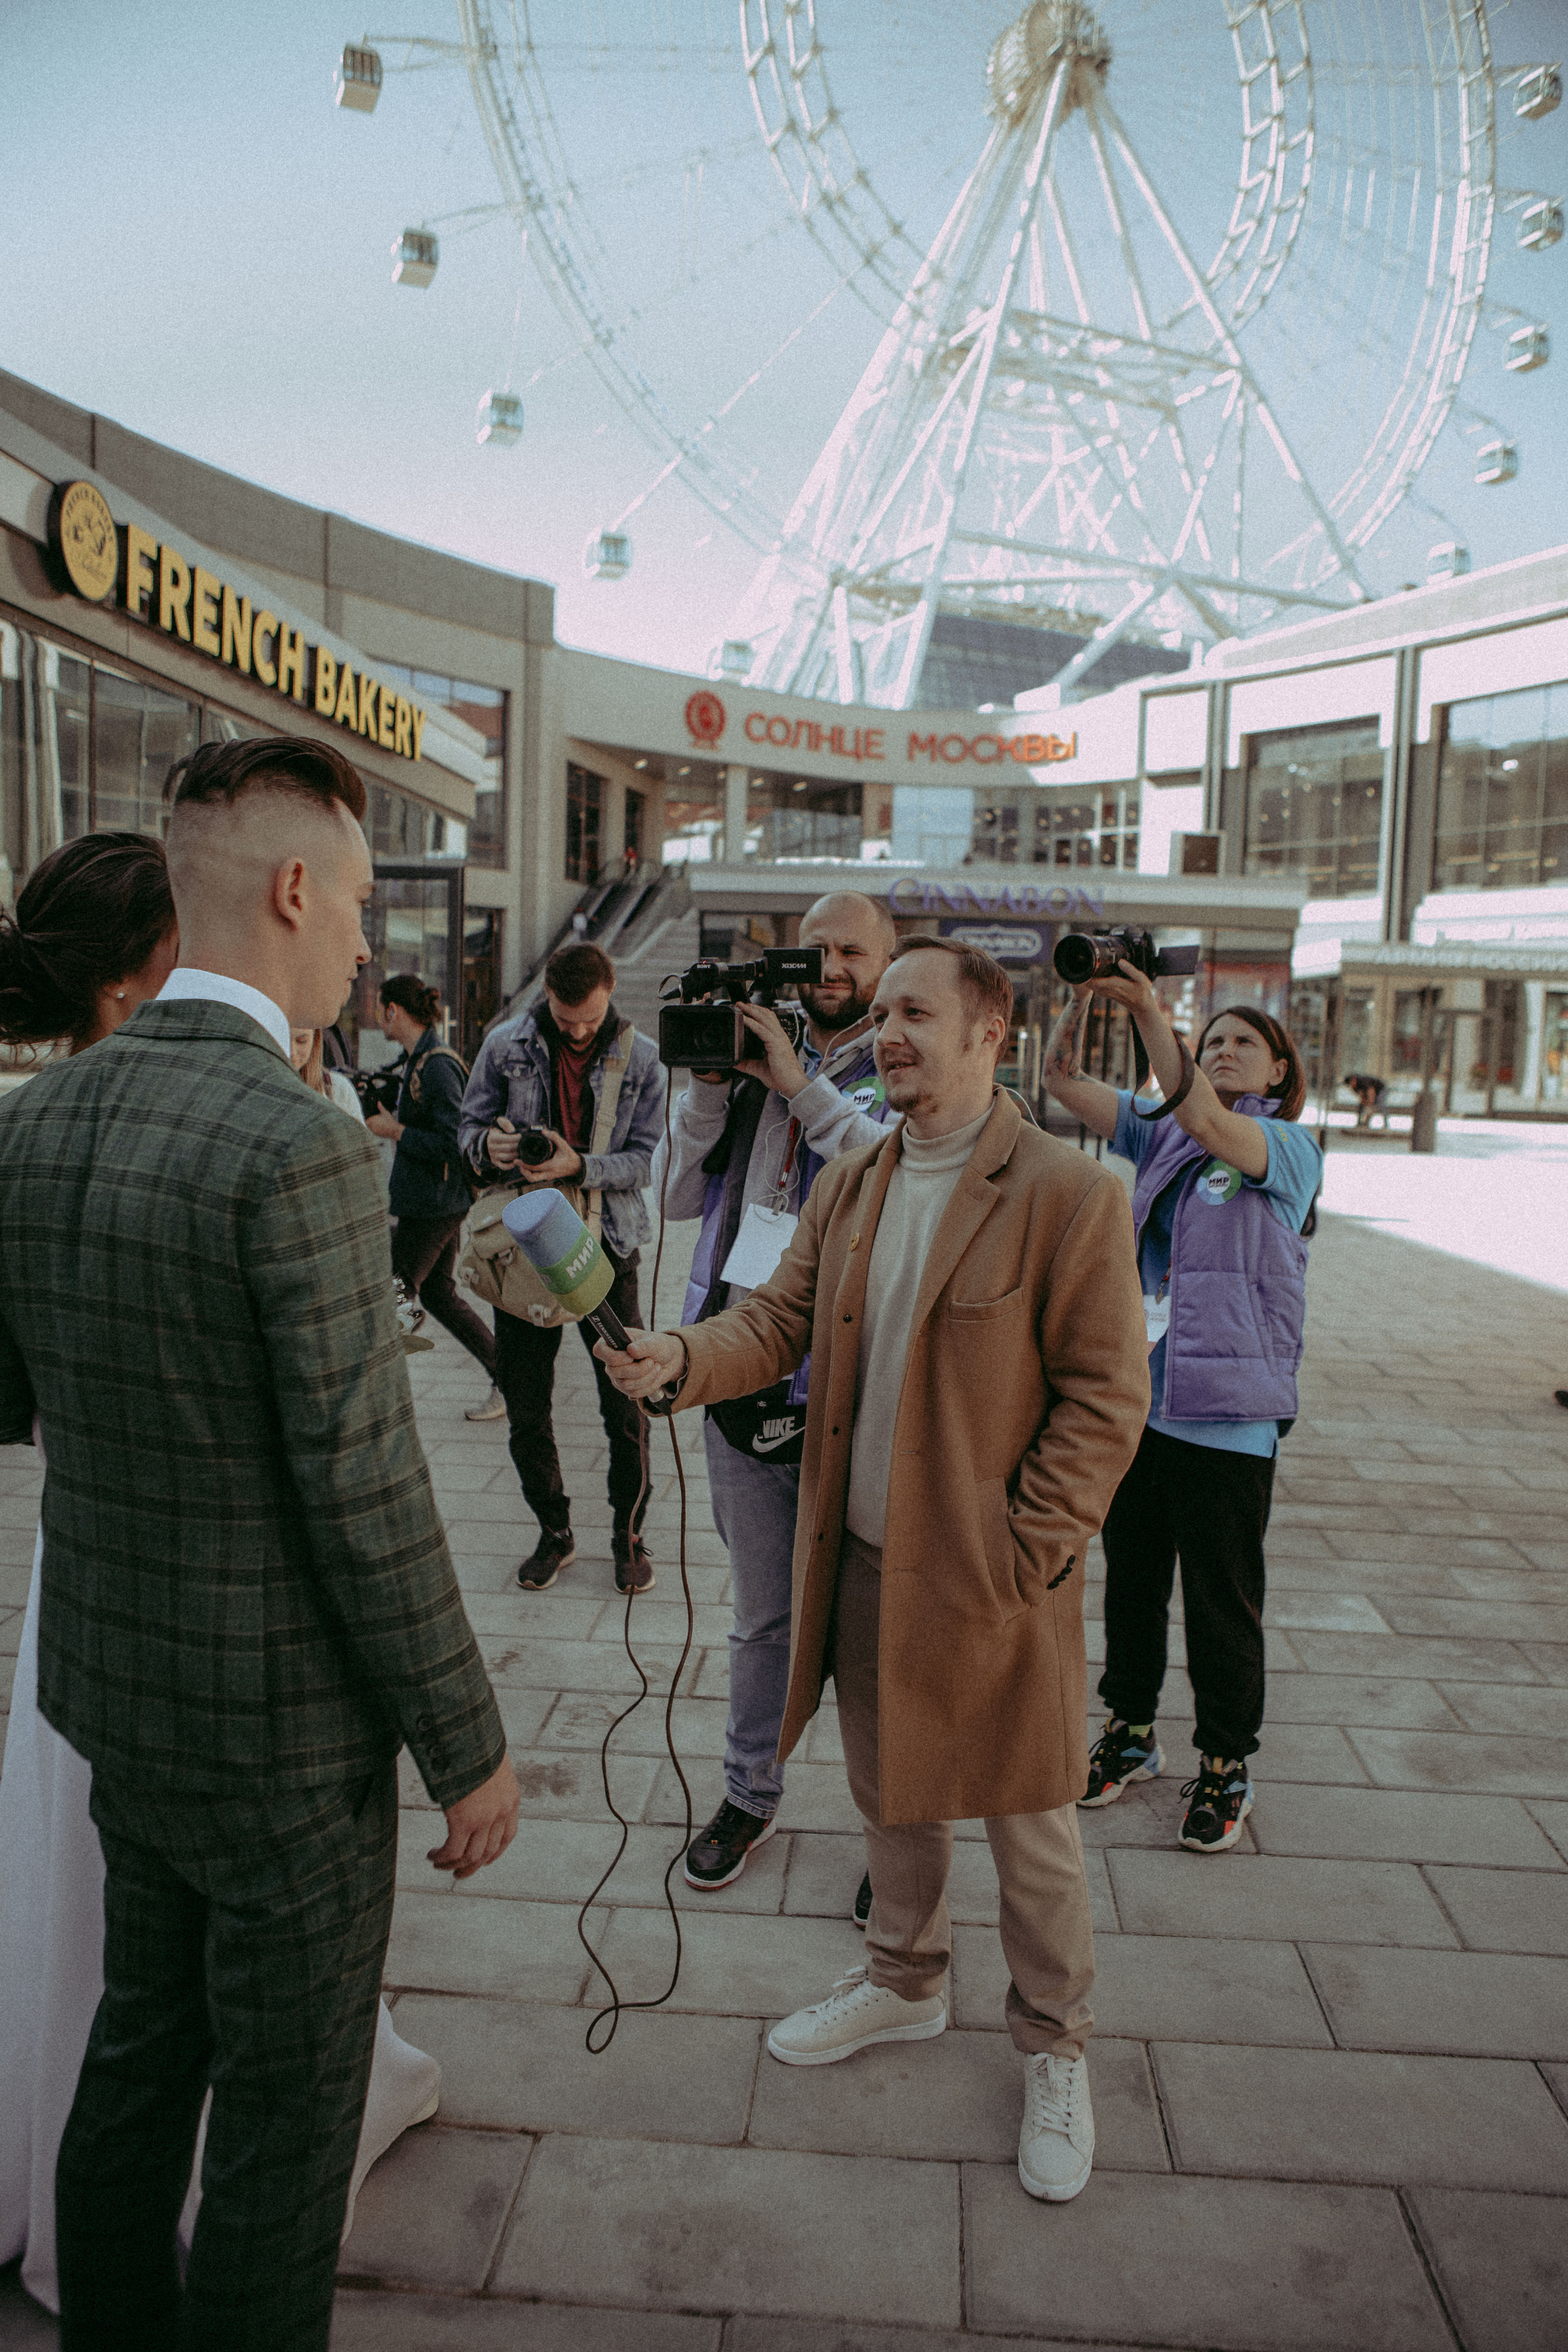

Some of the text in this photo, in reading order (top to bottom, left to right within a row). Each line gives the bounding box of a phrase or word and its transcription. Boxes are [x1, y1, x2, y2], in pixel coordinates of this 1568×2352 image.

[127, 522, 426, 761] FRENCH BAKERY
[745, 712, 1077, 764] СОЛНЦЕ МОСКВЫ
[889, 877, 1103, 916] CINNABON
[854, 1093, 875, 1102] МИР
[1208, 1177, 1229, 1185] МИР
[565, 1236, 594, 1279] МИР
[597, 1322, 619, 1349] SENNHEISER
